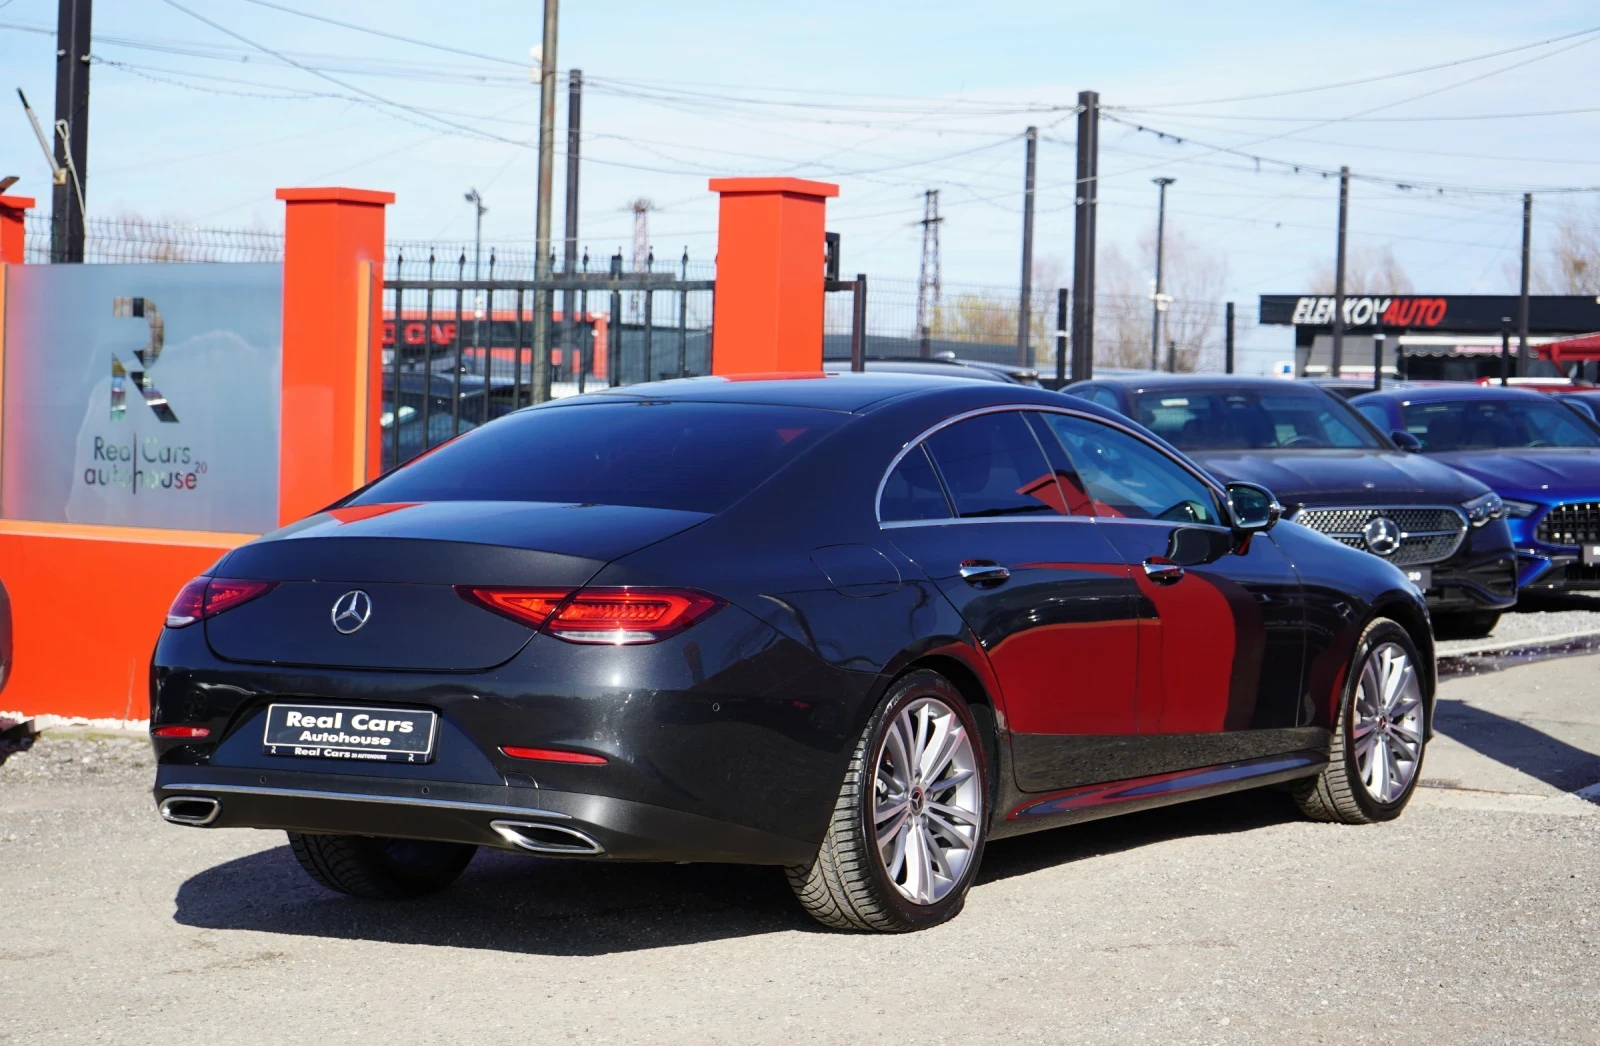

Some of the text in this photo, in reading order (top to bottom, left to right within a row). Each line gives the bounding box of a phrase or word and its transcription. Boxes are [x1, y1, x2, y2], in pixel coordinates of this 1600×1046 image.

[142, 437, 191, 464] Cars
[84, 464, 197, 491] autohouse
[286, 711, 414, 733] Real Cars
[299, 731, 392, 746] Autohouse
[294, 747, 320, 756] Real
[323, 749, 351, 759] Cars
